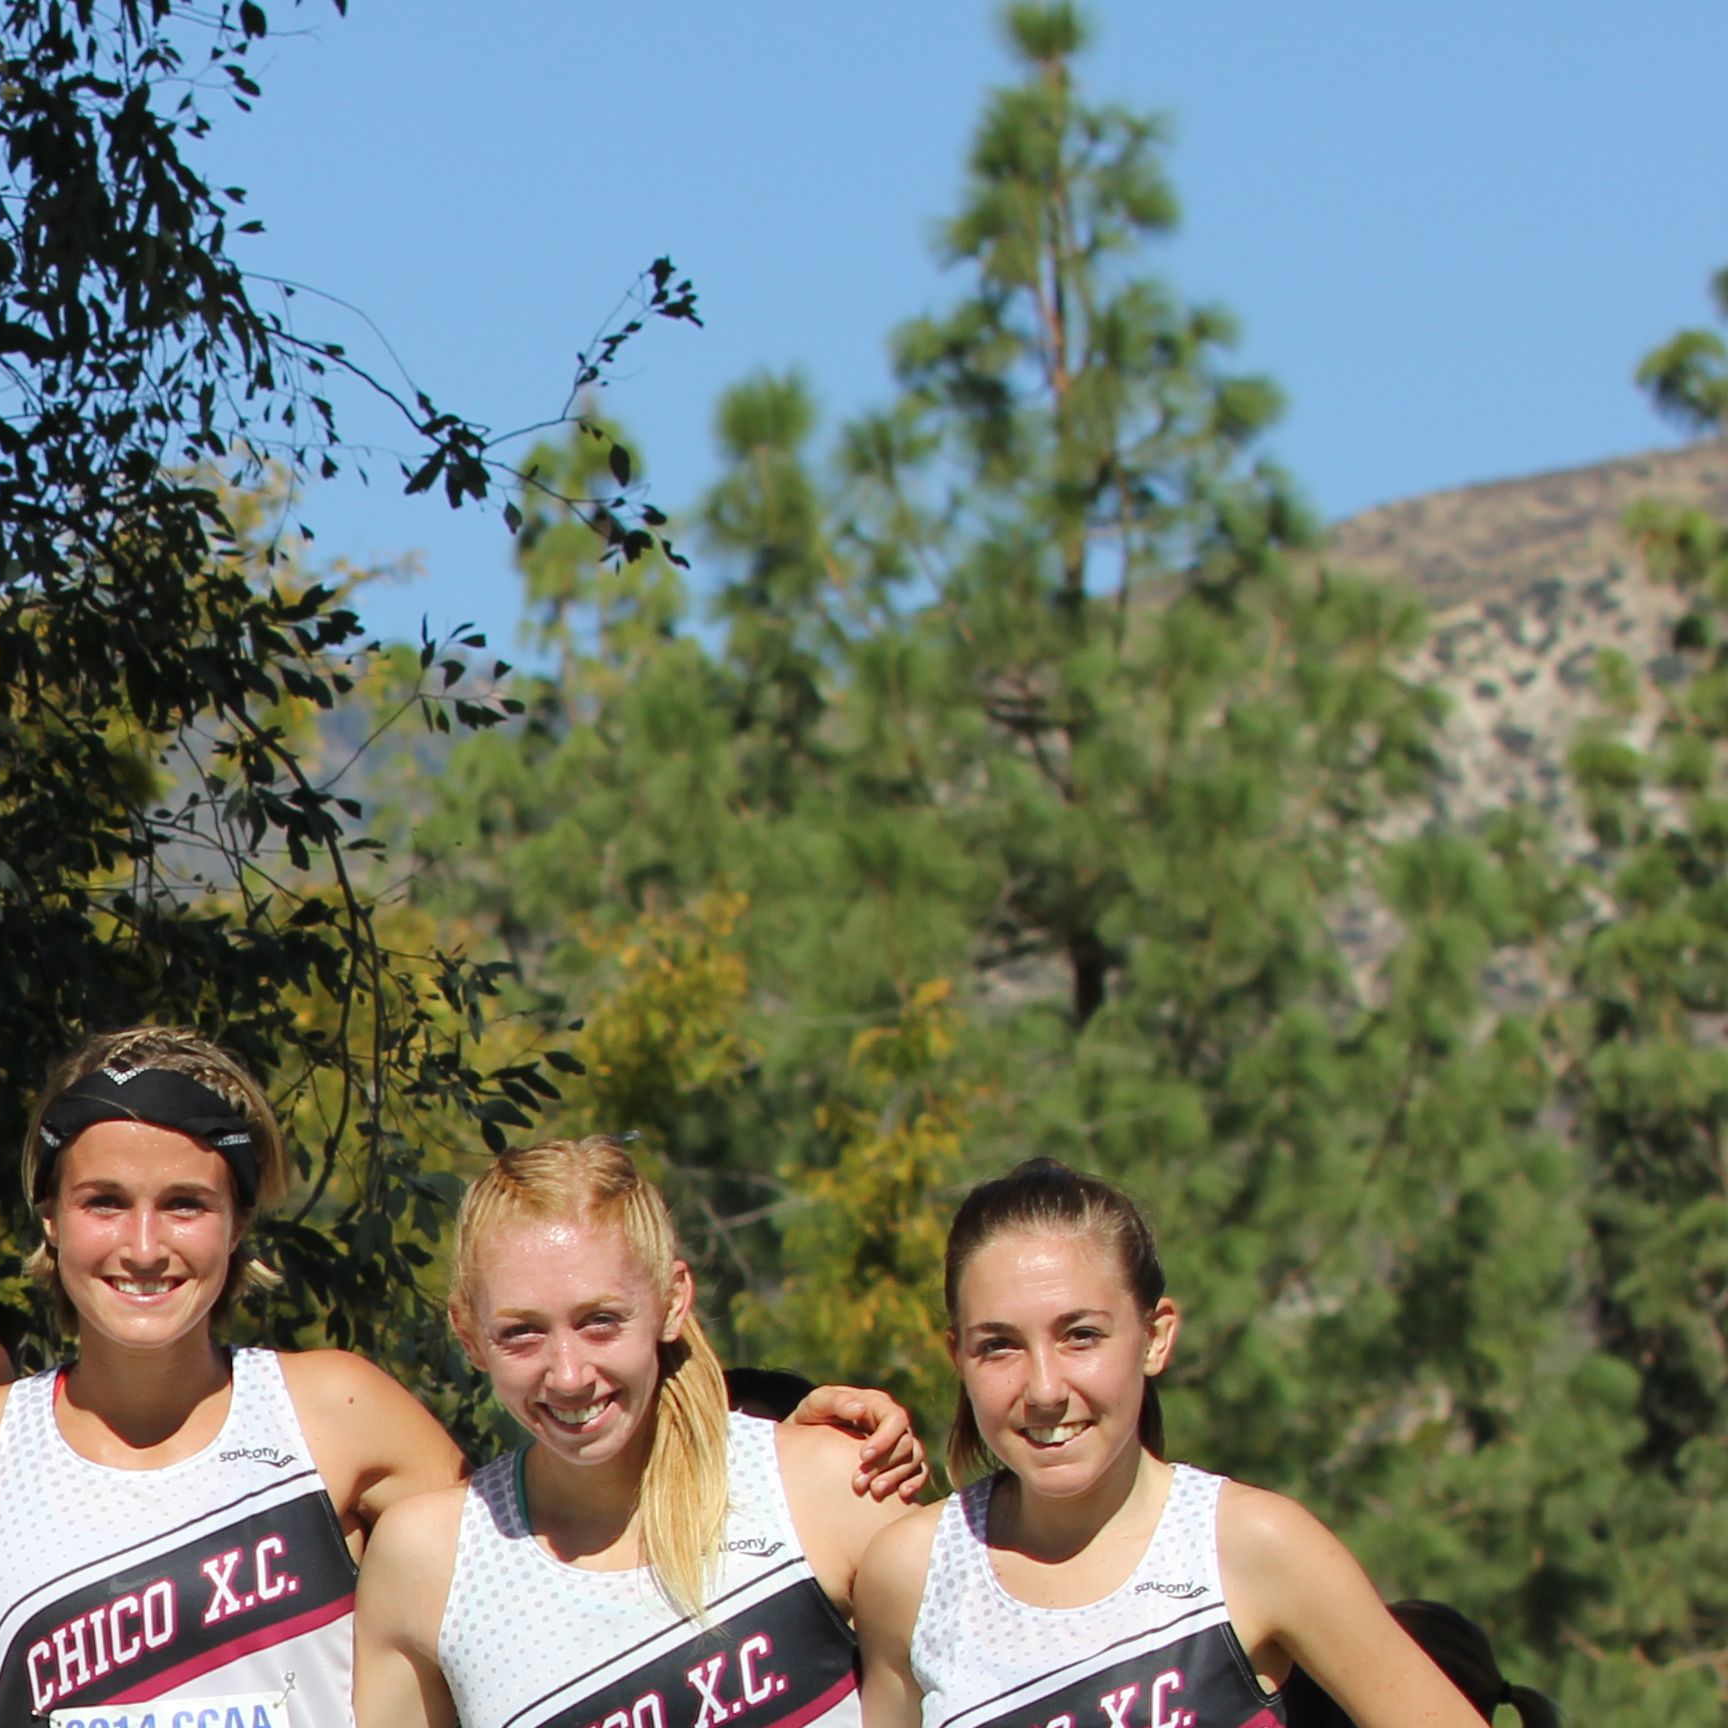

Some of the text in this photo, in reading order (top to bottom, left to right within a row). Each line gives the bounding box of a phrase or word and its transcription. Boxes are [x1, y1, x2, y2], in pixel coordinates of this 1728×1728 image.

[219, 1448, 279, 1464] saucony
[700, 1536, 767, 1556] ucony
[1134, 1580, 1193, 1595] saucony
[27, 1537, 299, 1711] CHICO X.C.
